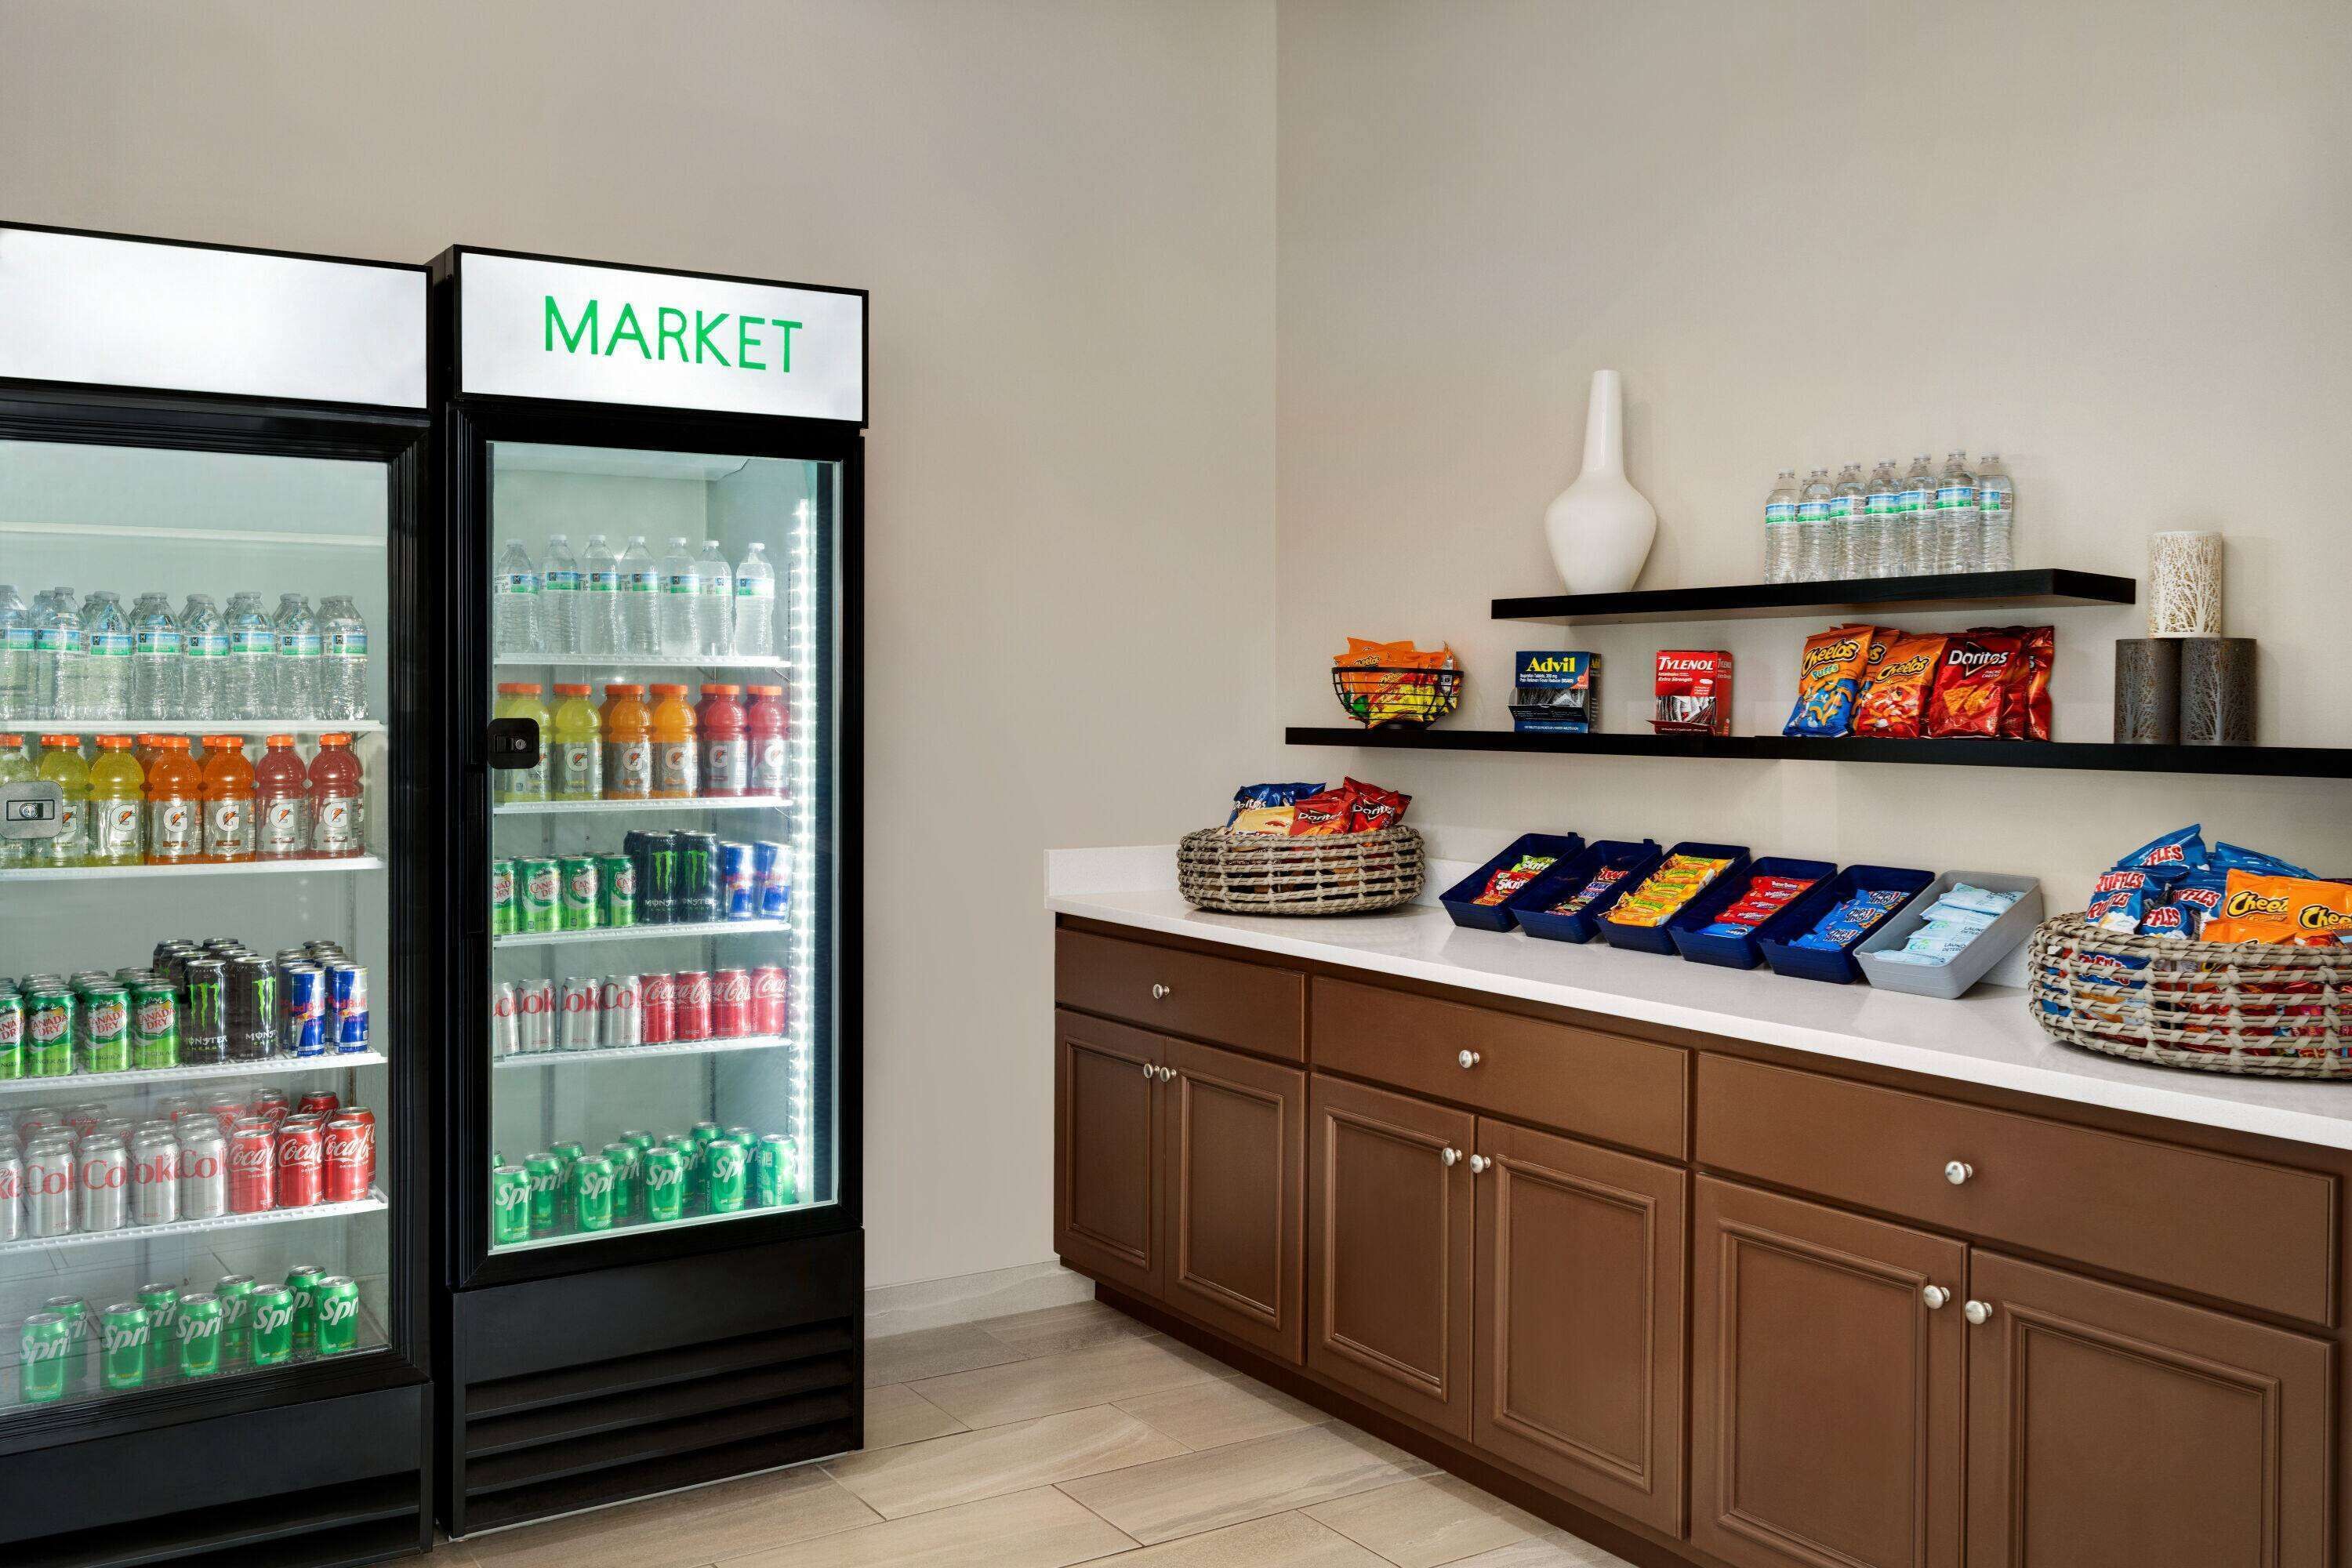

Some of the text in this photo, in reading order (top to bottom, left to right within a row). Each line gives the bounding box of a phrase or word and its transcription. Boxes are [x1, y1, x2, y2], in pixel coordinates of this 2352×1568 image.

[545, 295, 803, 373] MARKET
[1526, 657, 1575, 672] Advil
[1658, 656, 1713, 670] TYLENOL
[1801, 638, 1860, 679] Cheetos
[1875, 655, 1931, 683] Cheetos
[1948, 650, 2009, 666] Doritos
[110, 804, 136, 831] G
[163, 805, 188, 832] G
[216, 805, 240, 831] G
[270, 803, 294, 829] G
[323, 802, 347, 828] G
[2095, 872, 2146, 892] RUFFLES
[2143, 907, 2181, 927] FFLES
[2299, 904, 2352, 930] Chee
[38, 1025, 60, 1036] DRY
[97, 1022, 118, 1033] DRY
[147, 1018, 168, 1030] DRY
[245, 1029, 276, 1041] MONS
[83, 1159, 129, 1189] Co
[134, 1156, 183, 1185] oke
[101, 1317, 151, 1355] Spri
[176, 1308, 223, 1345] Spri
[20, 1328, 71, 1366] Spri
